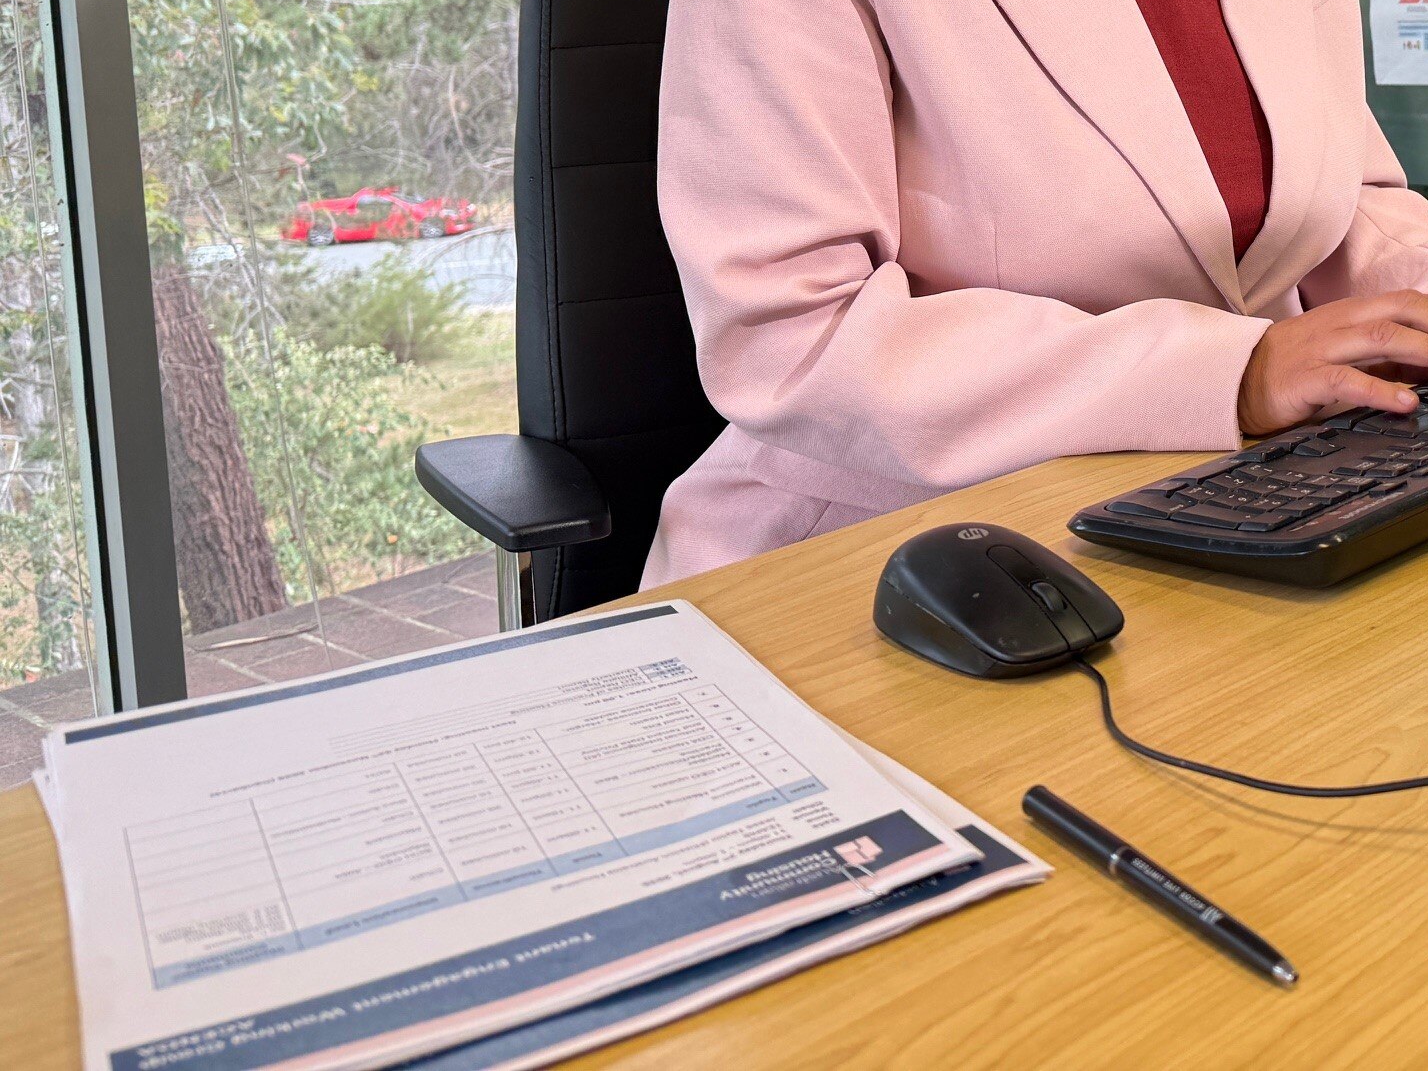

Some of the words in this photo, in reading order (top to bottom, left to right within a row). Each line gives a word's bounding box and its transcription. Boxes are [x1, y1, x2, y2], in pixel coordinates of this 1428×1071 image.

[719, 857, 835, 899] Community
[746, 850, 829, 880] Housing
[515, 931, 592, 960] Tenant
[353, 958, 509, 1011] Engagement
[232, 1007, 345, 1045] Working
